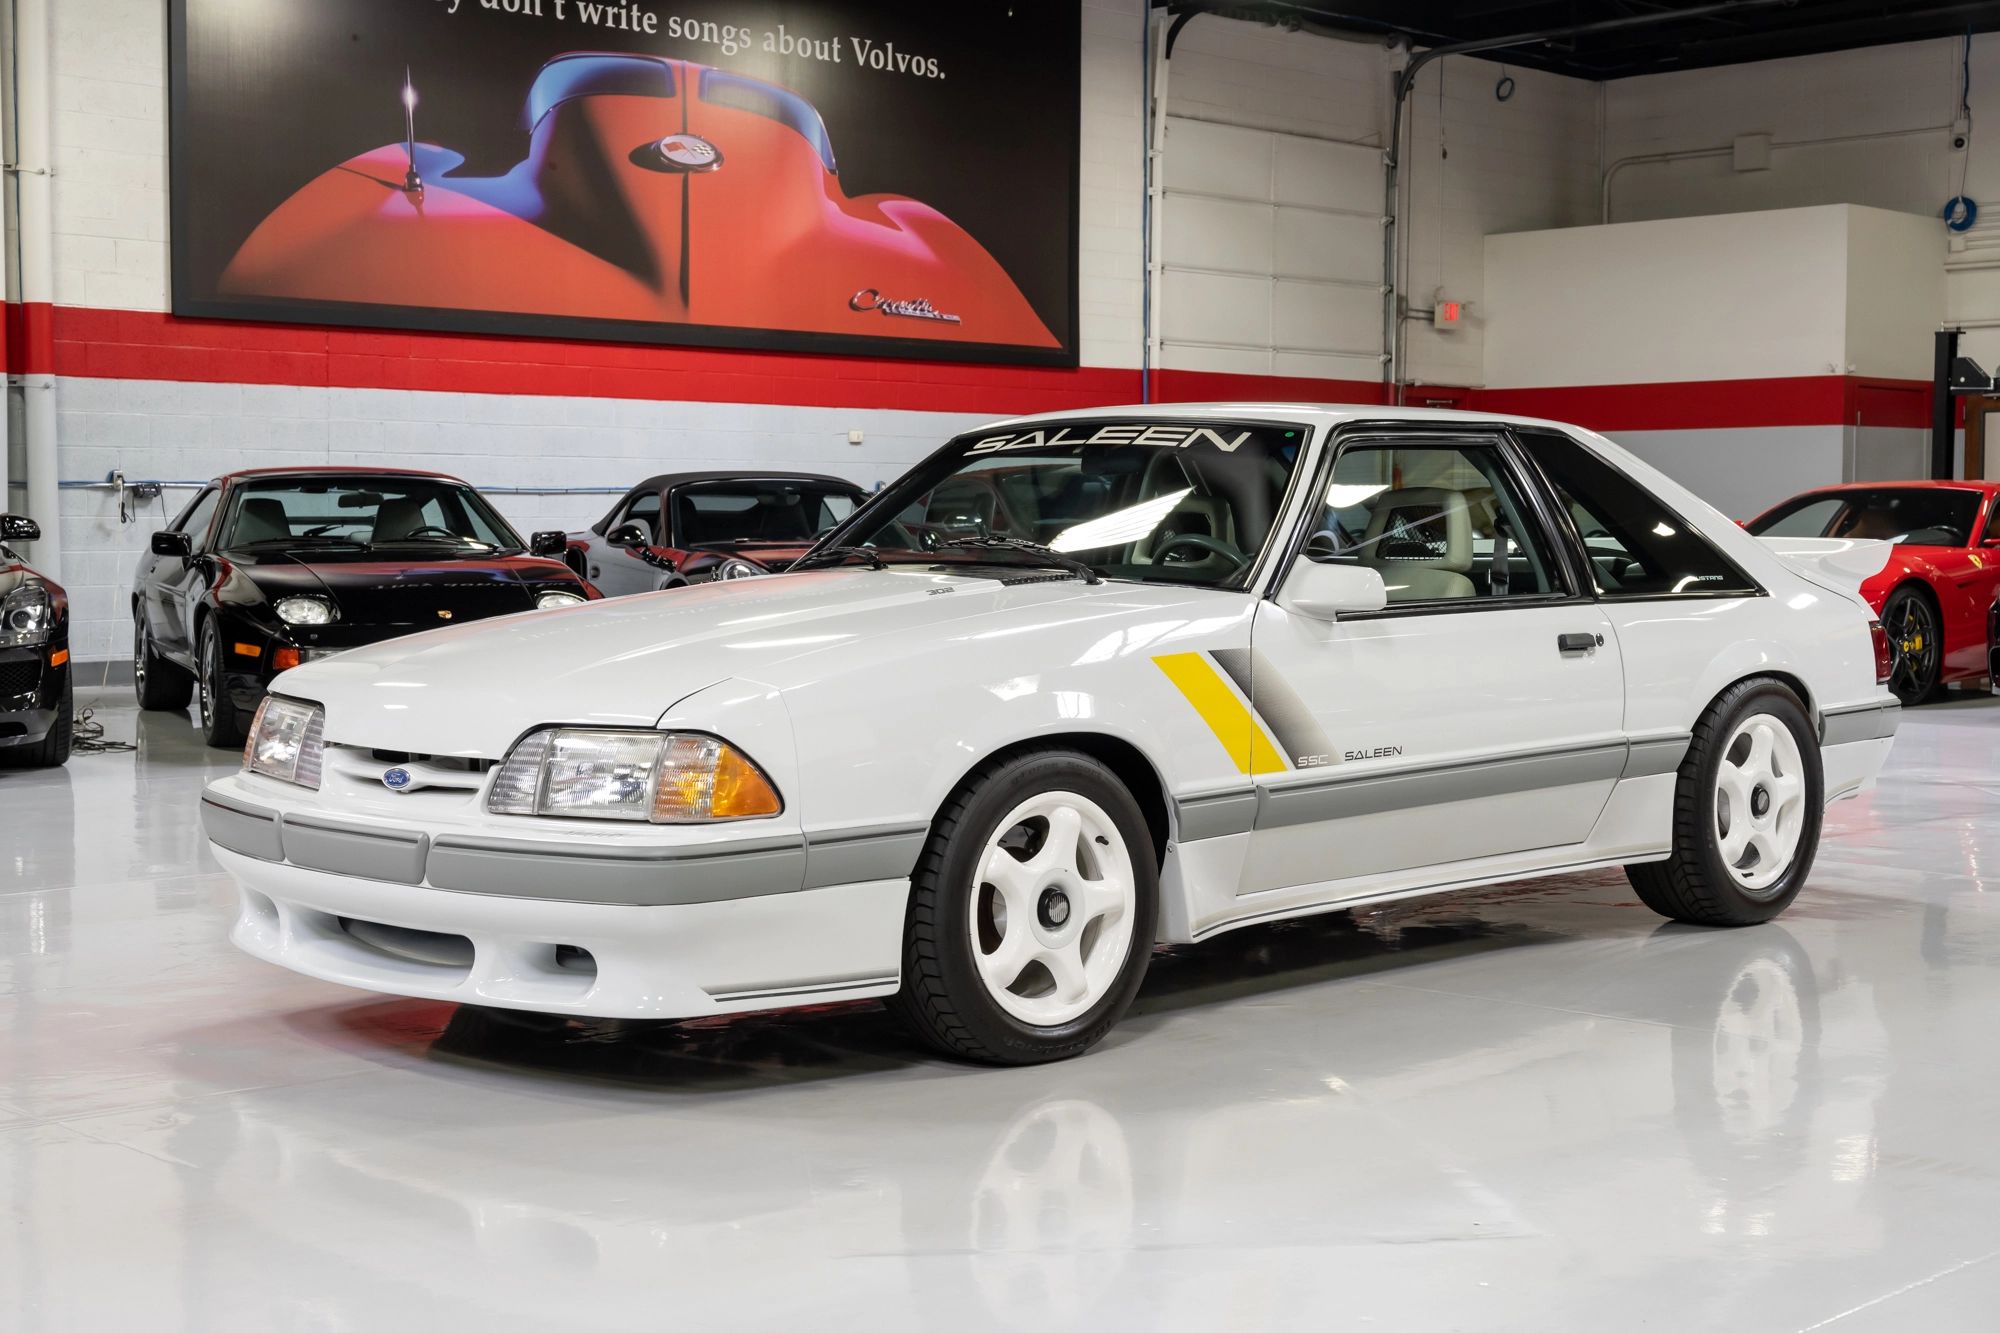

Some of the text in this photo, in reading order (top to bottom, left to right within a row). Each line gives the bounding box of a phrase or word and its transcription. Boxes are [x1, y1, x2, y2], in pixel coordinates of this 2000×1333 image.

[576, 0, 658, 34] write
[668, 14, 752, 56] songs
[762, 24, 842, 63] about
[849, 36, 947, 80] Volvos.
[963, 425, 1252, 457] SALEEN
[925, 586, 956, 597] 302
[1297, 745, 1403, 767] SSC SALEEN
